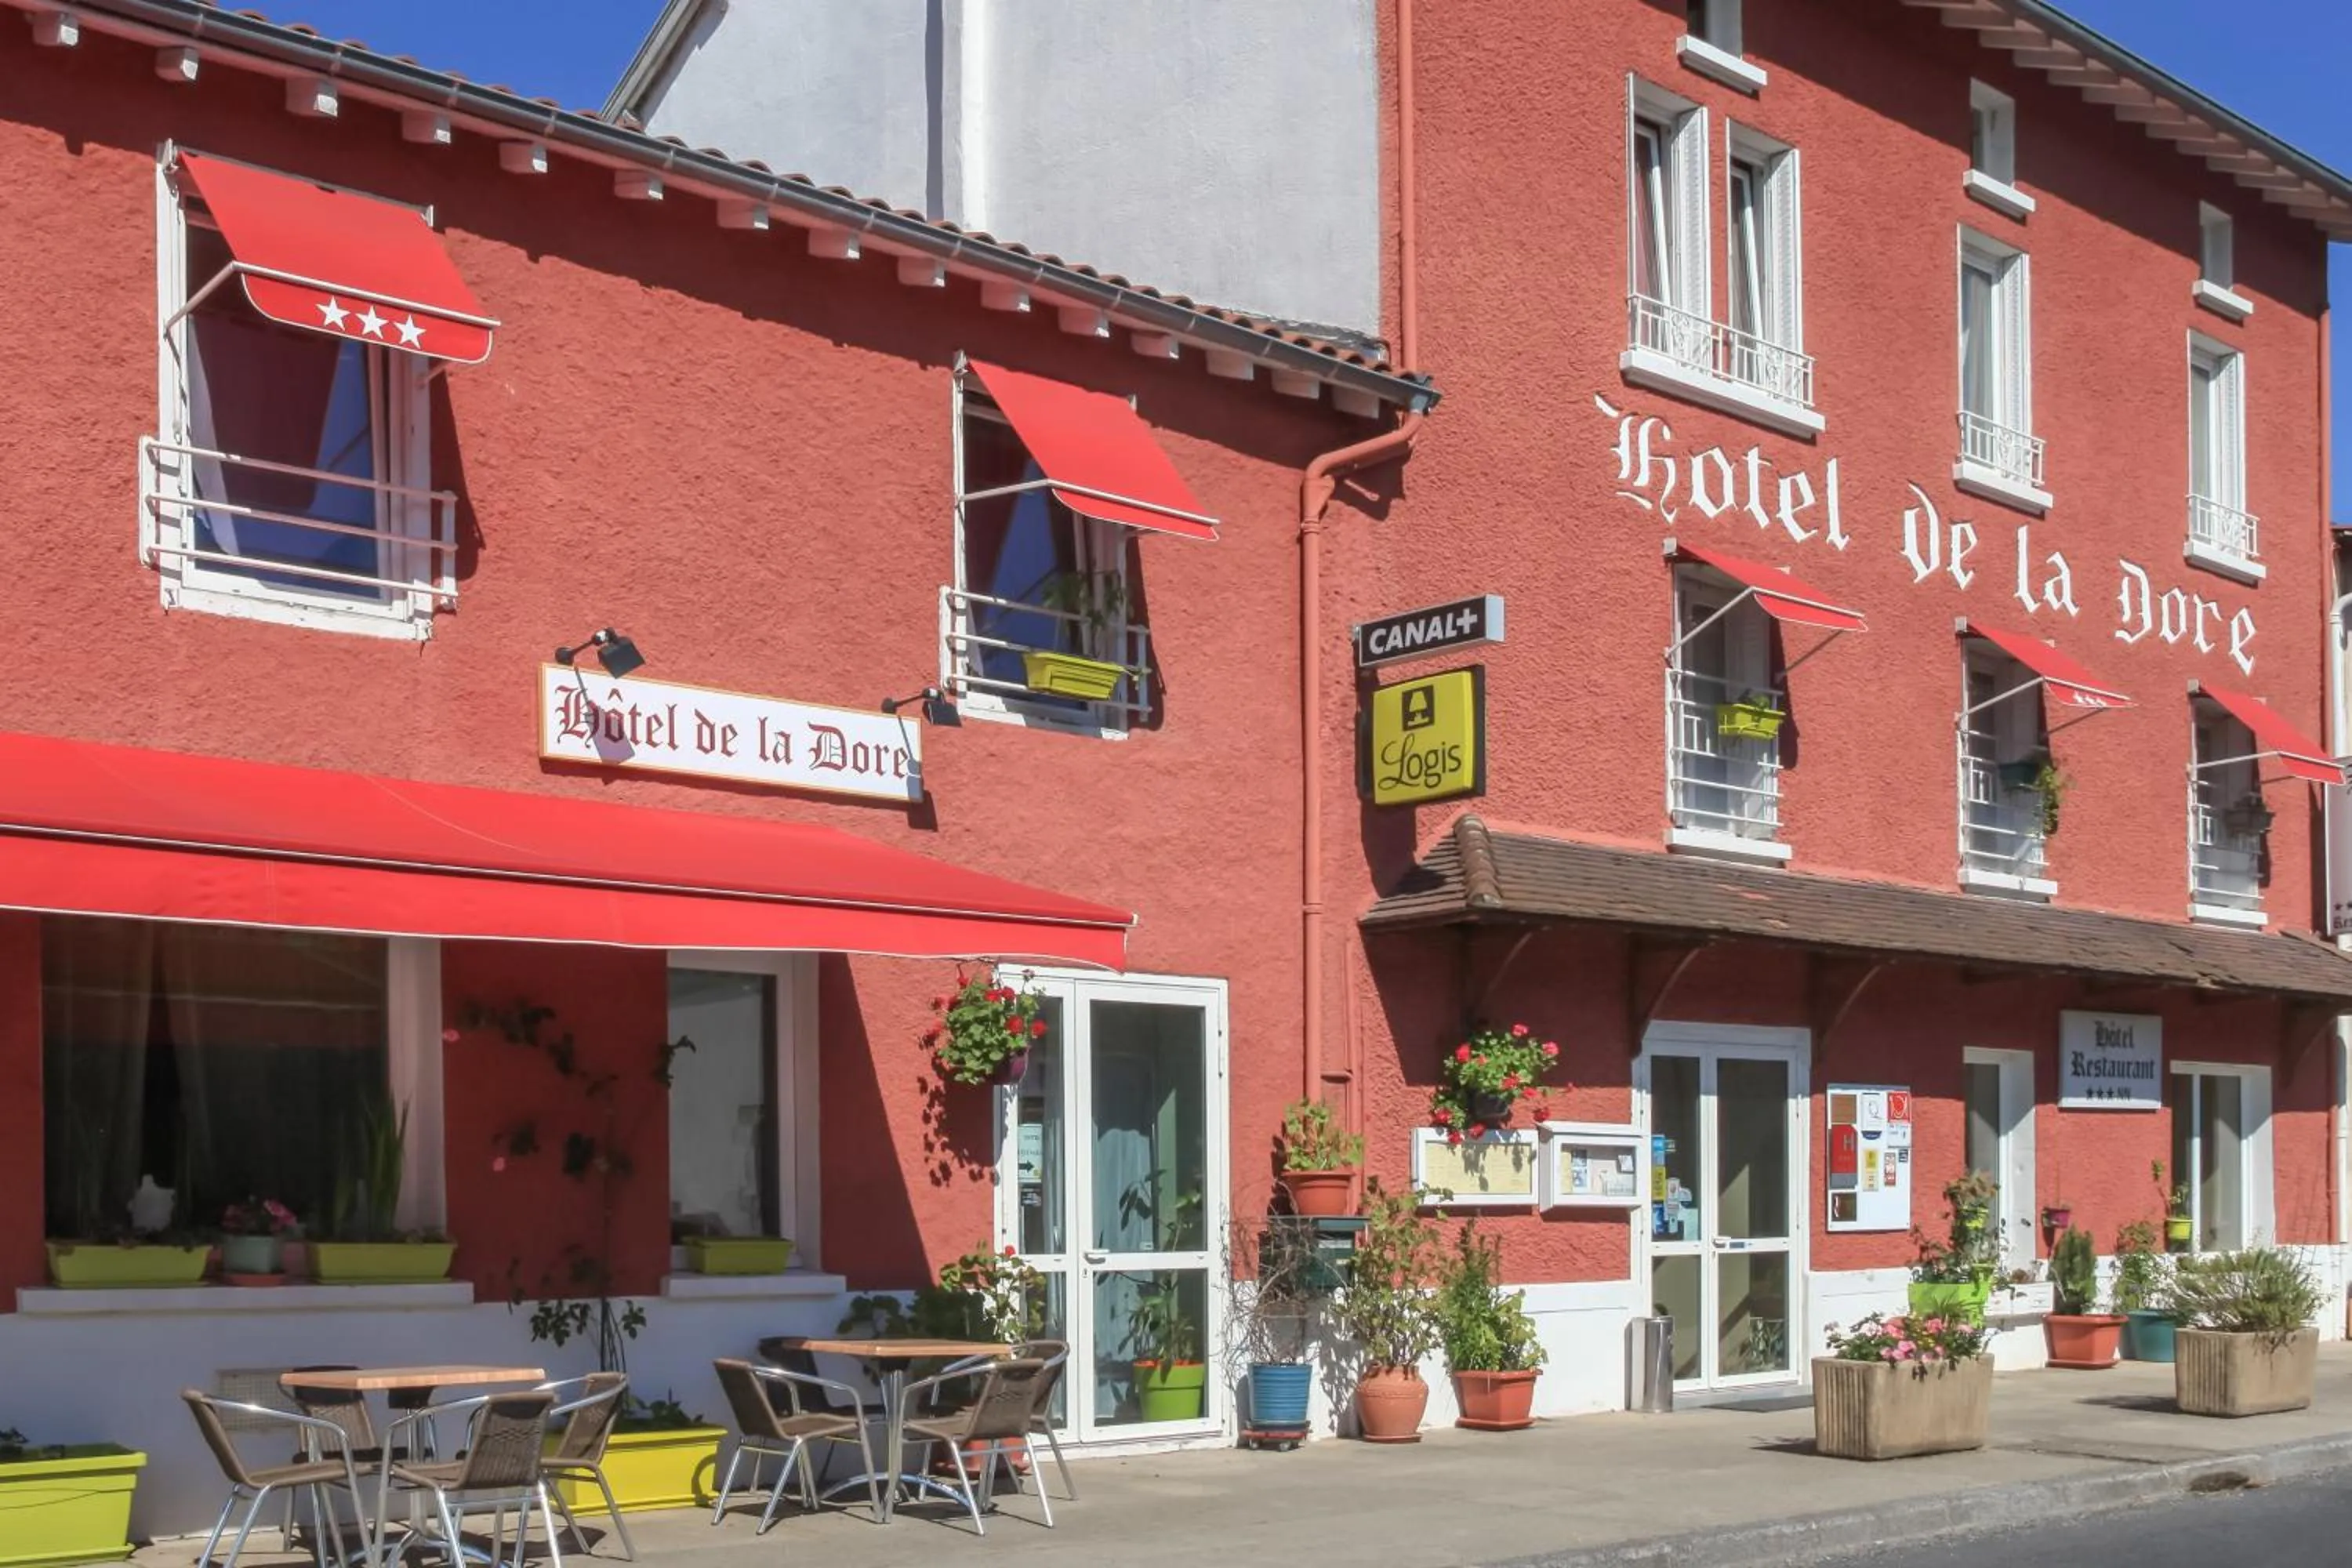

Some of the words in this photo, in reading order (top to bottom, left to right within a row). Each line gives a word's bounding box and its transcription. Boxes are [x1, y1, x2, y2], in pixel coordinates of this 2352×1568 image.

[1594, 393, 1850, 551] Hotel
[2013, 525, 2081, 617] la
[2115, 559, 2257, 677] Dore
[1369, 608, 1478, 654] CANAL+
[555, 685, 680, 750] Hôtel
[694, 709, 739, 757] de
[757, 717, 793, 765] la
[808, 722, 909, 779] Dore
[1378, 734, 1462, 789] Logis
[2094, 1021, 2134, 1050] Hôtel
[2071, 1051, 2155, 1079] Restaurant
